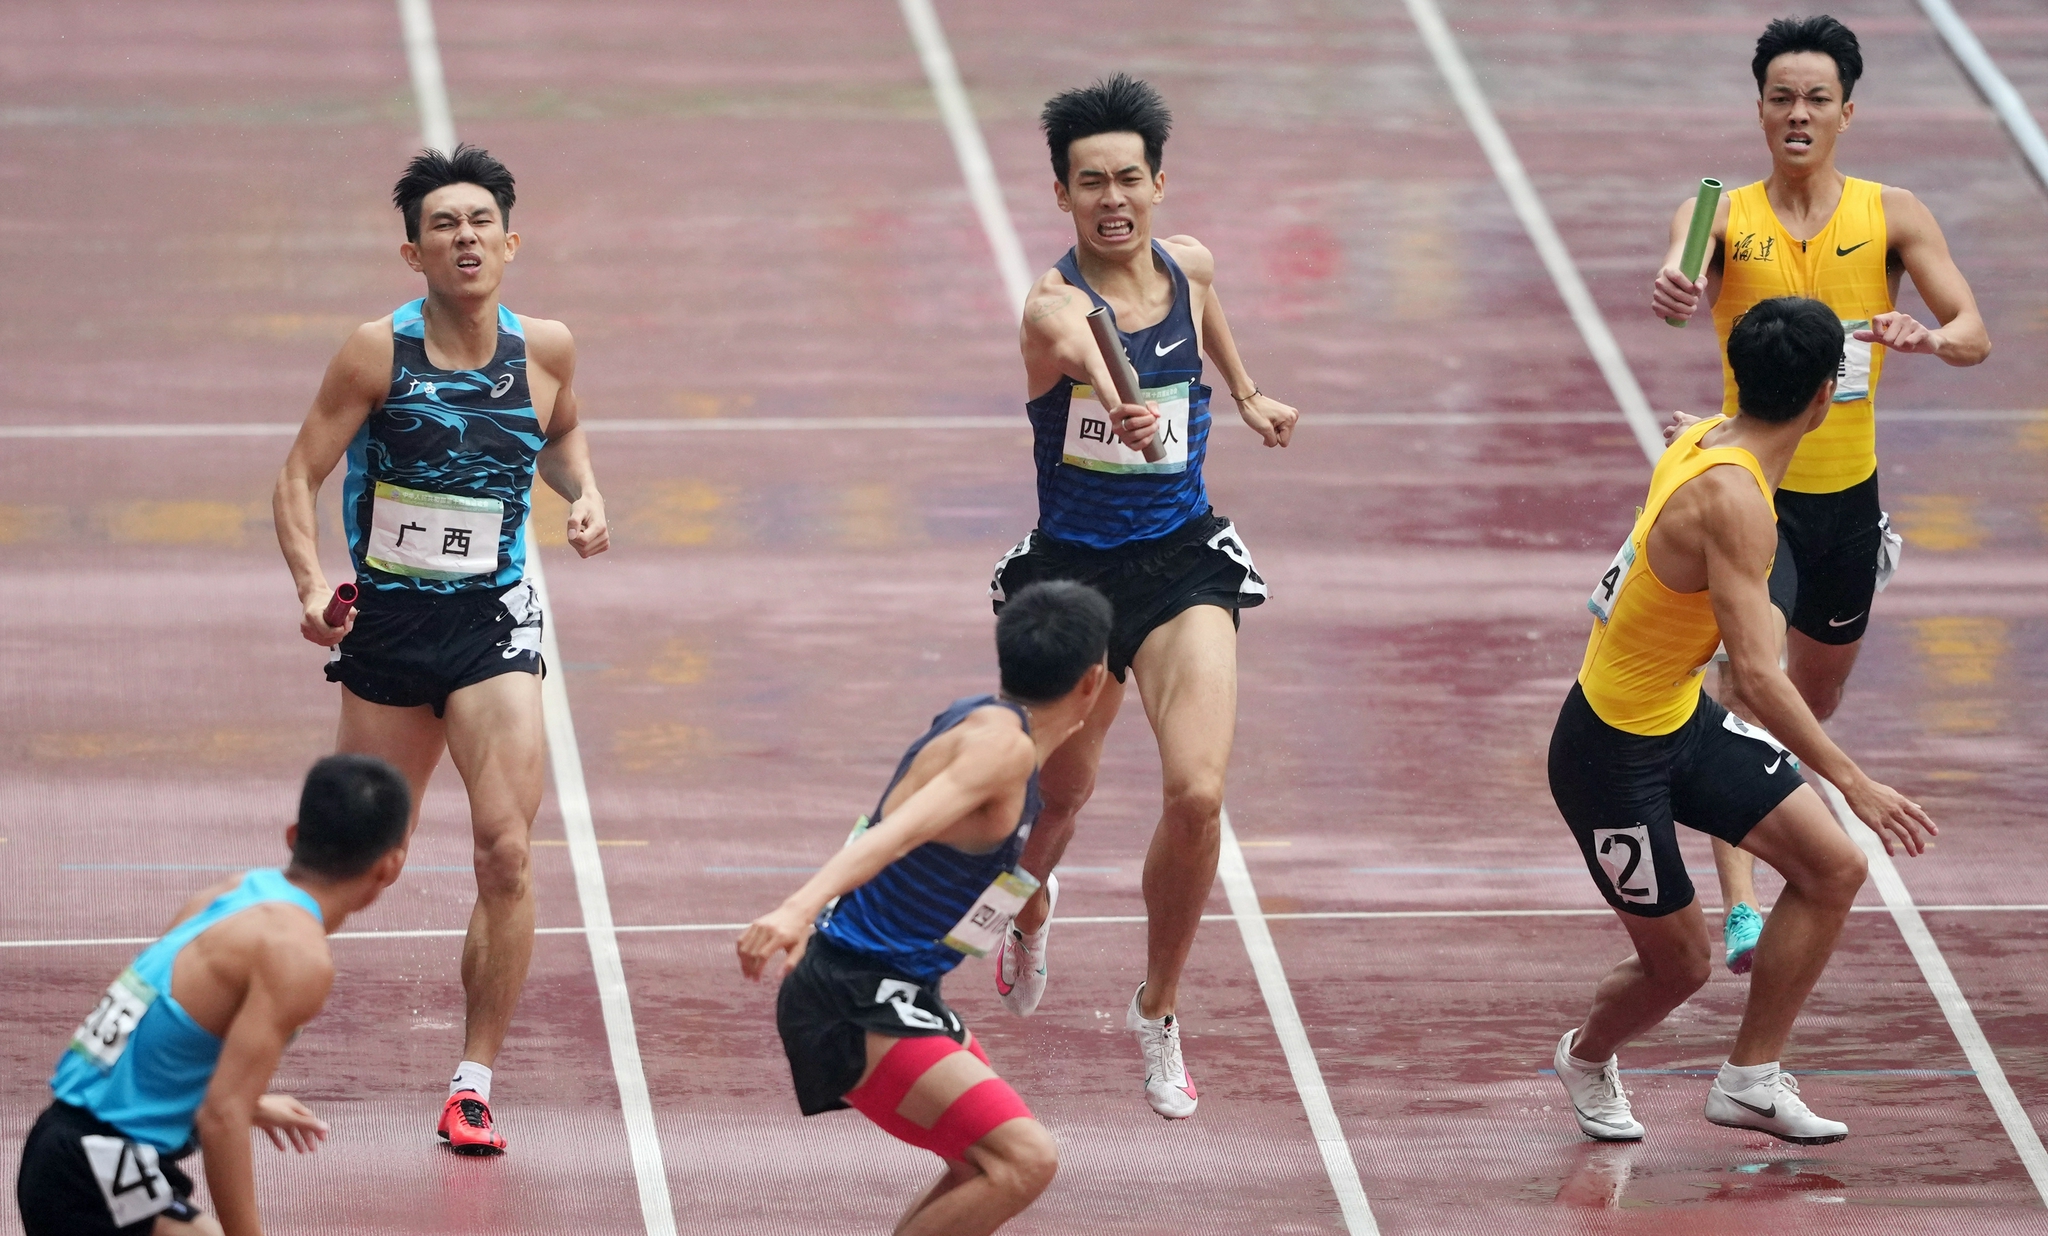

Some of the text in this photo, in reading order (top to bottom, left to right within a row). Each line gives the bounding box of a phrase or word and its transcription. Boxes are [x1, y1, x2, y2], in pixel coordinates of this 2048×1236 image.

[1732, 231, 1775, 262] 福建
[407, 378, 437, 395] 广西
[1079, 417, 1179, 446] 四人
[395, 521, 473, 557] 广西
[1601, 565, 1621, 602] 4
[1600, 833, 1650, 897] 2
[112, 1139, 159, 1201] 4
